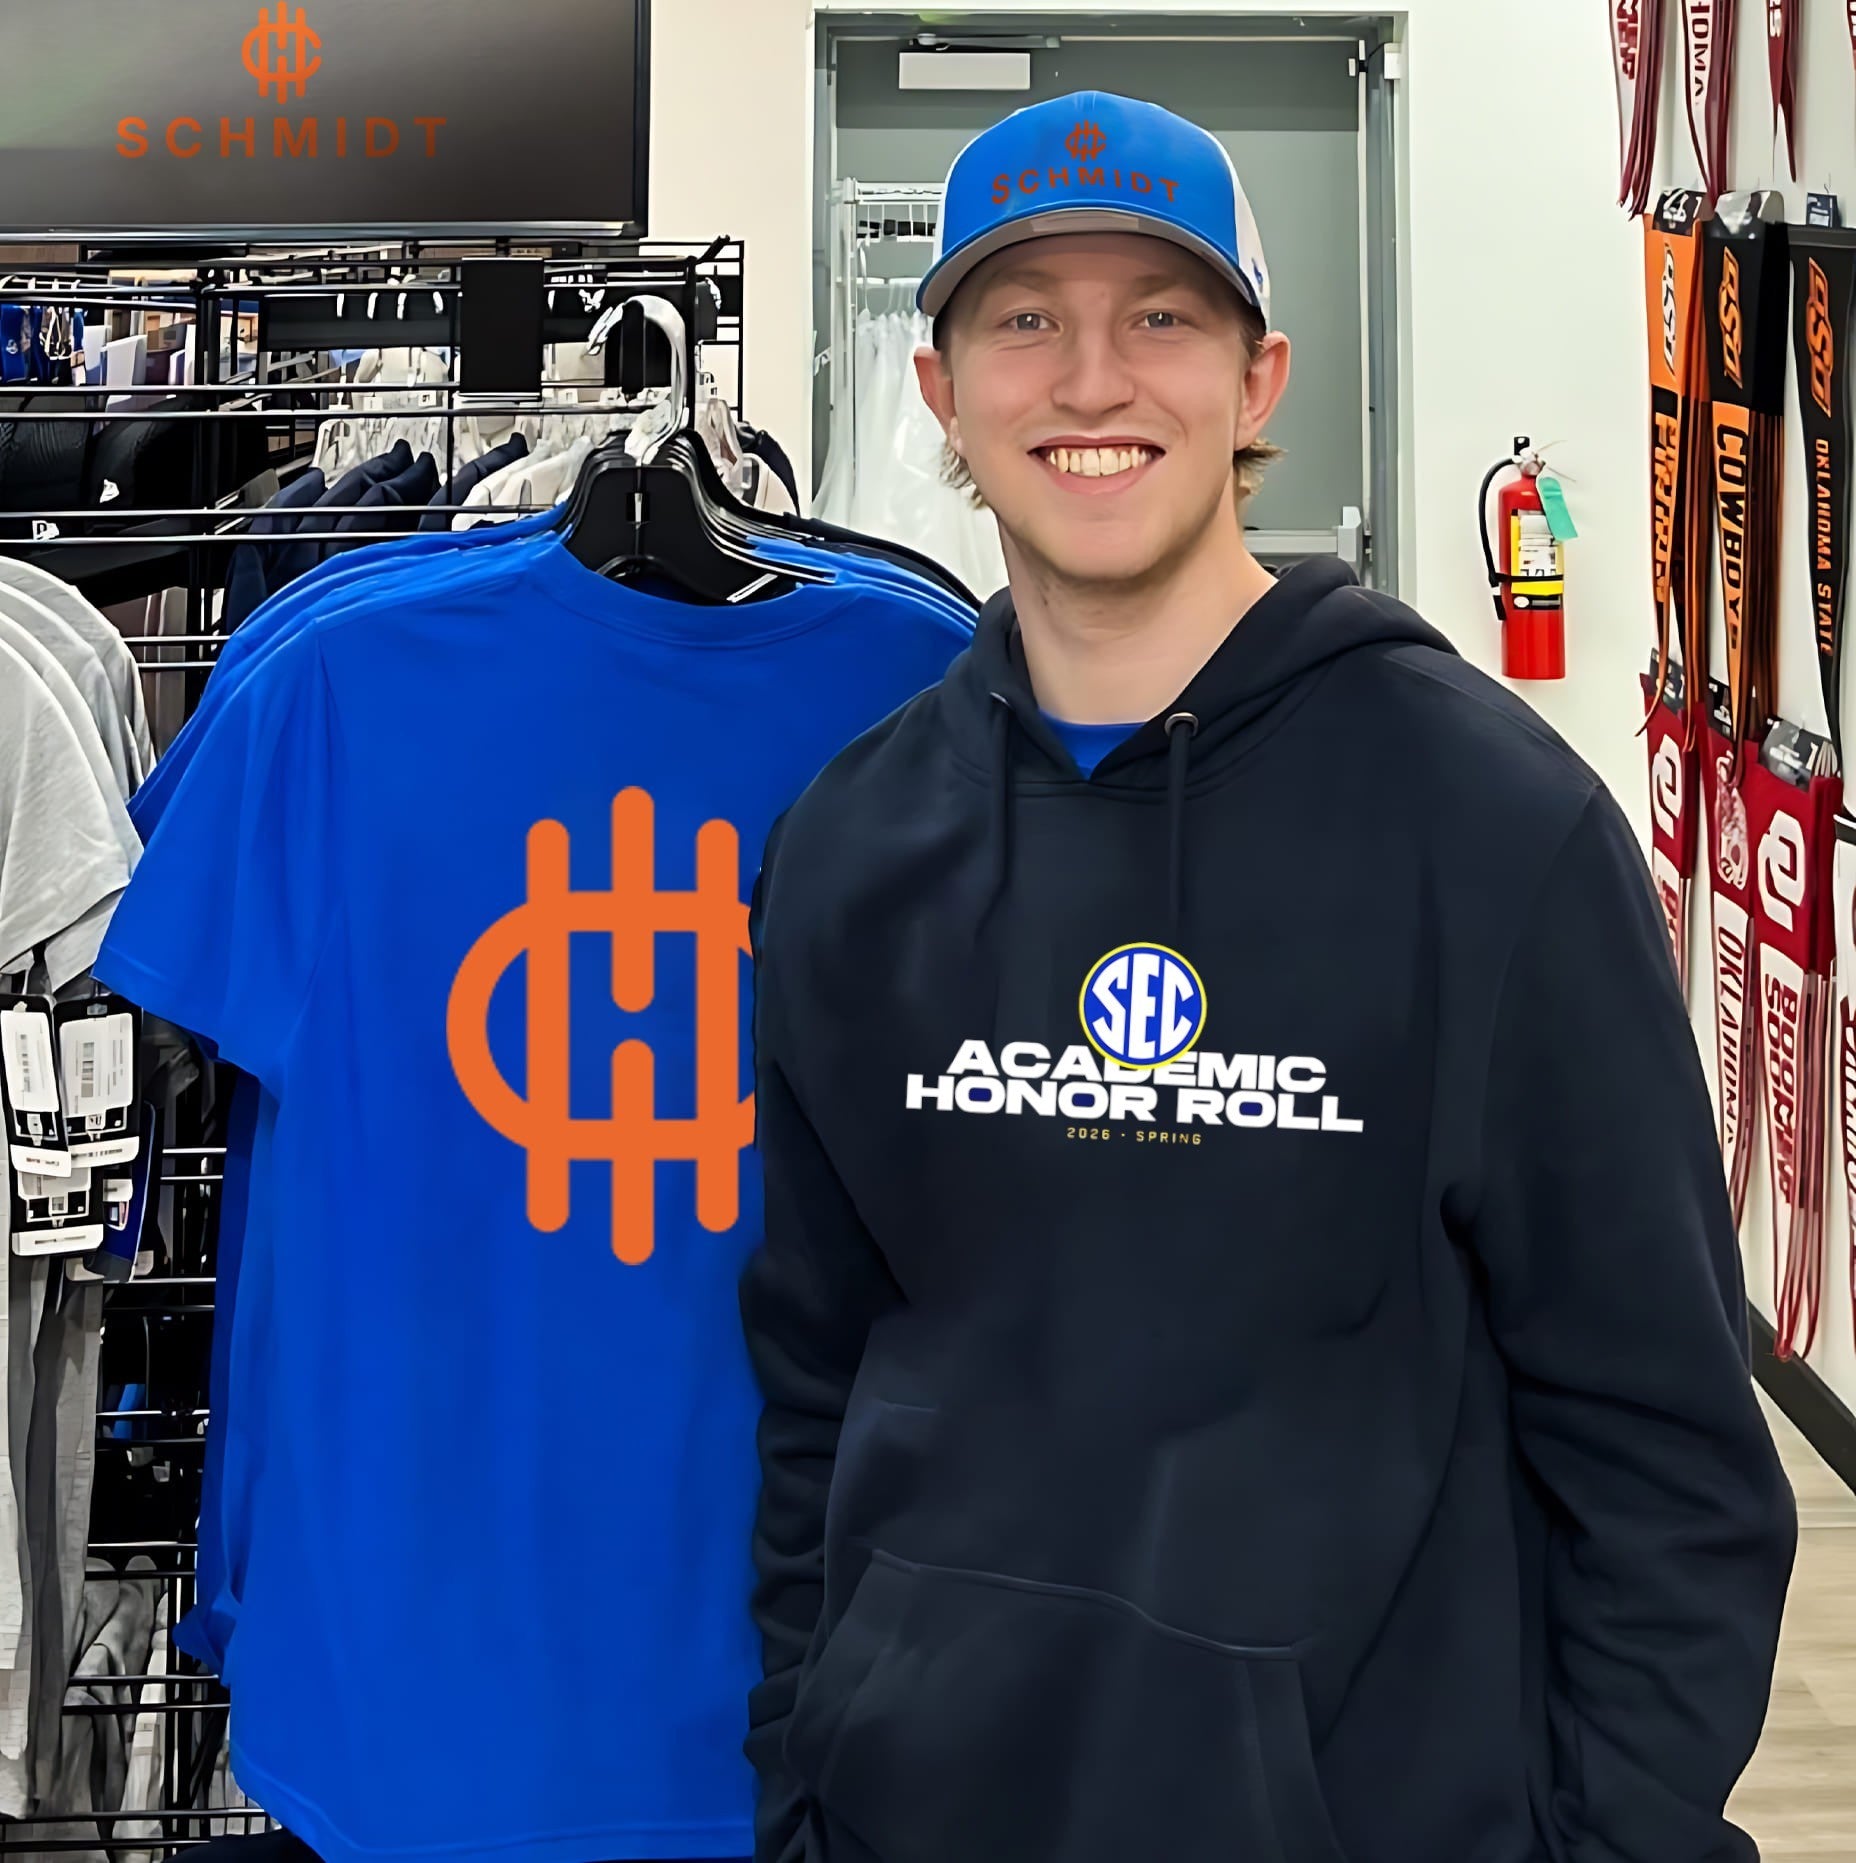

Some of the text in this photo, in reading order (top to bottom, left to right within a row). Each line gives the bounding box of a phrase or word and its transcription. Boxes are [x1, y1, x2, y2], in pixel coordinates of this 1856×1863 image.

[116, 116, 447, 158] SCHMIDT
[992, 167, 1179, 204] SCHMIDT
[1815, 439, 1832, 570] OKLAHOMA
[1091, 952, 1194, 1060] SEC
[1719, 927, 1745, 1143] OKLAHOMA
[946, 1039, 1327, 1093] ACADEMIC
[906, 1073, 1364, 1133] HONOR ROLL
[1067, 1127, 1201, 1145] 2026 SPRING
